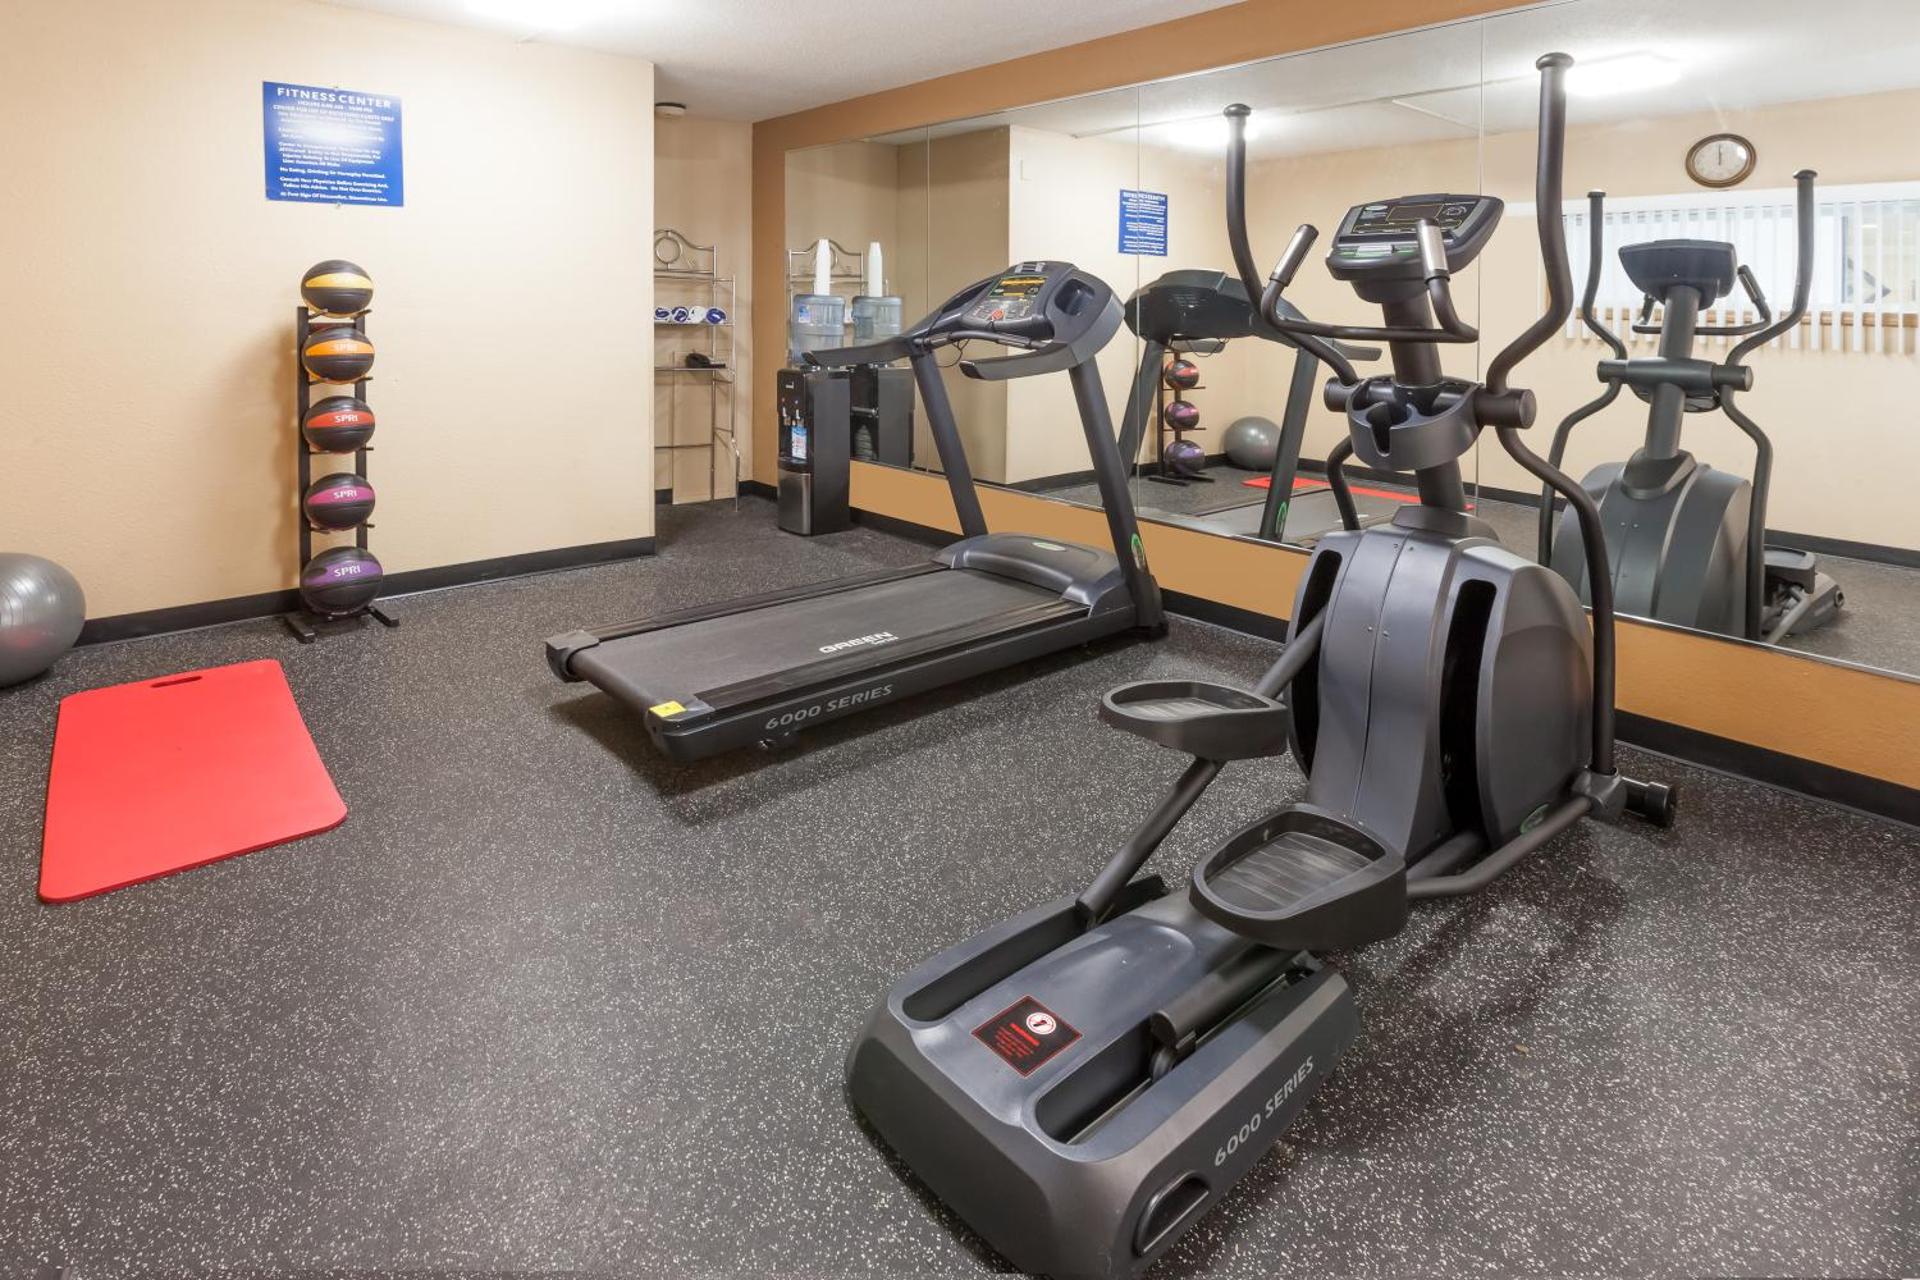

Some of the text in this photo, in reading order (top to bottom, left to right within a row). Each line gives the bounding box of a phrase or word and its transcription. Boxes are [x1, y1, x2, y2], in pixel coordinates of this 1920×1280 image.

[277, 88, 336, 102] FITNESS
[338, 94, 391, 108] CENTER
[335, 413, 358, 423] SPRI
[333, 488, 357, 499] SPRI
[333, 565, 361, 577] SPRI
[818, 631, 894, 653] GREEN
[765, 684, 893, 729] 6000 SERIES
[1214, 1056, 1313, 1167] 6000 SERIES
